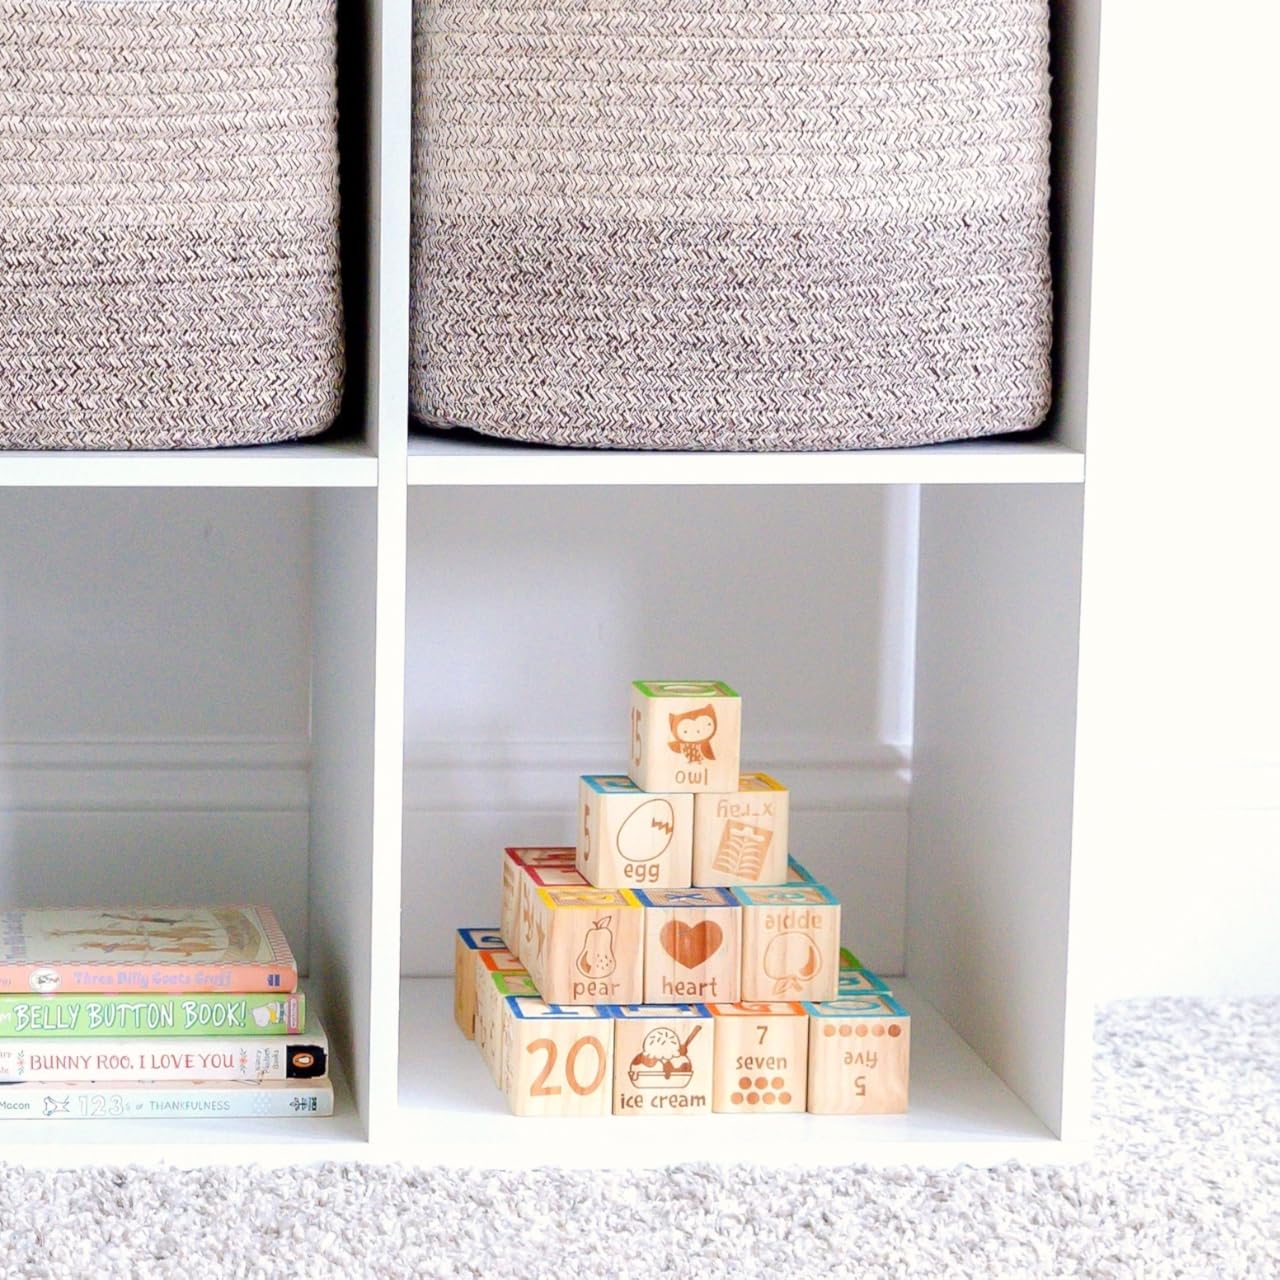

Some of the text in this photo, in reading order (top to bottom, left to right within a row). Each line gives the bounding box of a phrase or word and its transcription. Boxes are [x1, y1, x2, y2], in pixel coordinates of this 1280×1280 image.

[675, 768, 709, 785] owl
[717, 799, 774, 817] x-ray
[623, 863, 660, 883] egg
[765, 911, 823, 930] apple
[73, 971, 113, 985] Three
[152, 971, 191, 985] Goats
[662, 976, 717, 997] heart
[573, 980, 621, 1000] pear
[13, 999, 248, 1032] BELLY BUTTON BOOK!
[756, 1025, 768, 1045] 7
[30, 1055, 92, 1070] BUNNY
[140, 1055, 147, 1069] I
[151, 1054, 195, 1069] LOVE
[198, 1053, 235, 1069] YOU
[526, 1035, 607, 1097] 20
[735, 1055, 787, 1070] seven
[844, 1050, 878, 1068] five
[854, 1076, 866, 1096] 5
[150, 1100, 231, 1111] THANKFULNESS
[620, 1093, 706, 1109] ice cream
